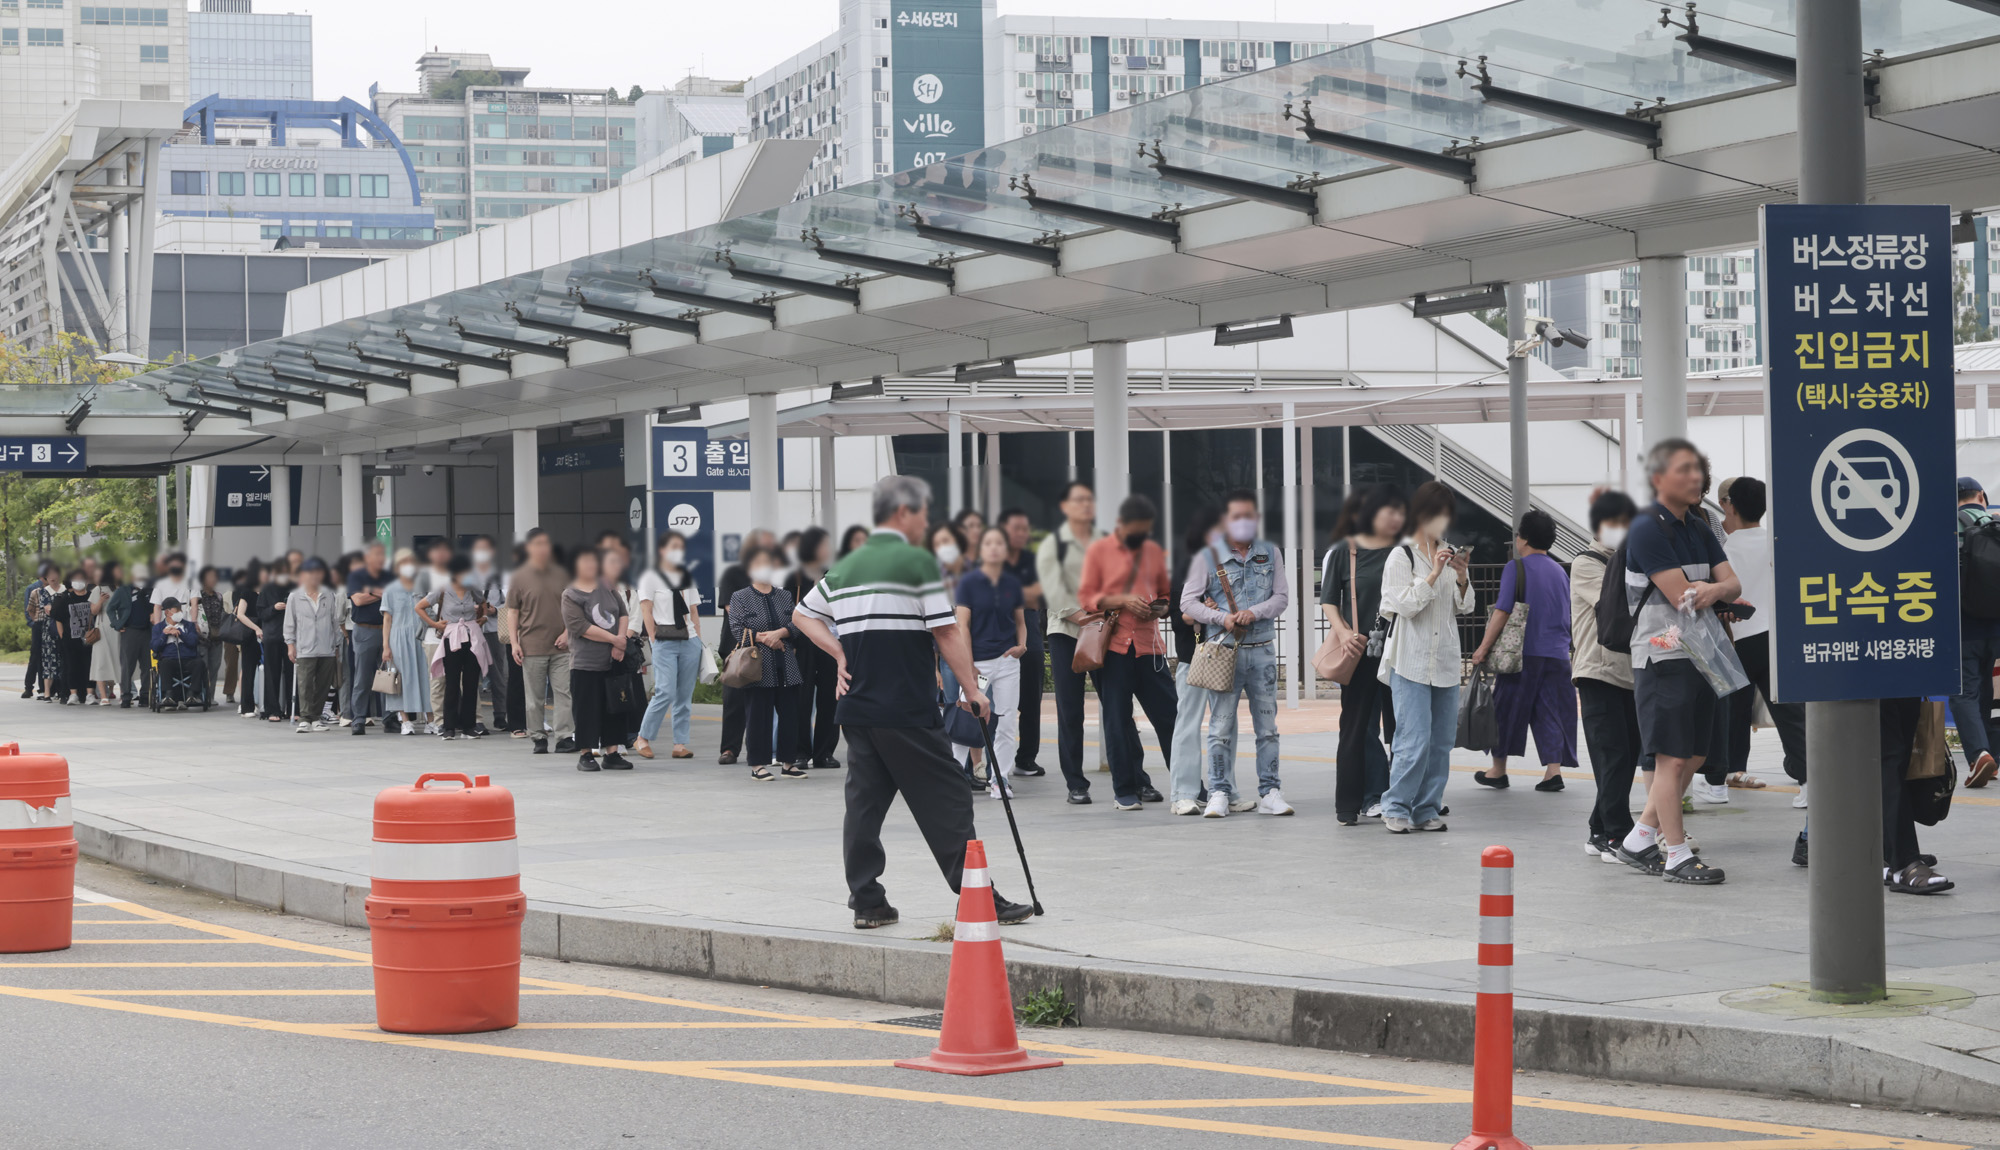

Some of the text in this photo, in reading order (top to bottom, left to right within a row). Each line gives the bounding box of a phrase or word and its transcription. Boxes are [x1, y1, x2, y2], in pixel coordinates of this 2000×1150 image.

[897, 11, 958, 28] 수서6단지
[246, 152, 319, 170] heerim
[1793, 234, 1929, 270] 버스정류장
[1794, 331, 1929, 369] 진입금지
[1796, 381, 1930, 412] (택시·승용차)
[37, 446, 46, 460] 3
[672, 444, 688, 472] 3
[706, 467, 750, 477] Gate 出入口
[670, 516, 699, 526] SRT
[1799, 571, 1937, 625] 단속중
[1803, 638, 1935, 663] 법규위반 사업용차량
